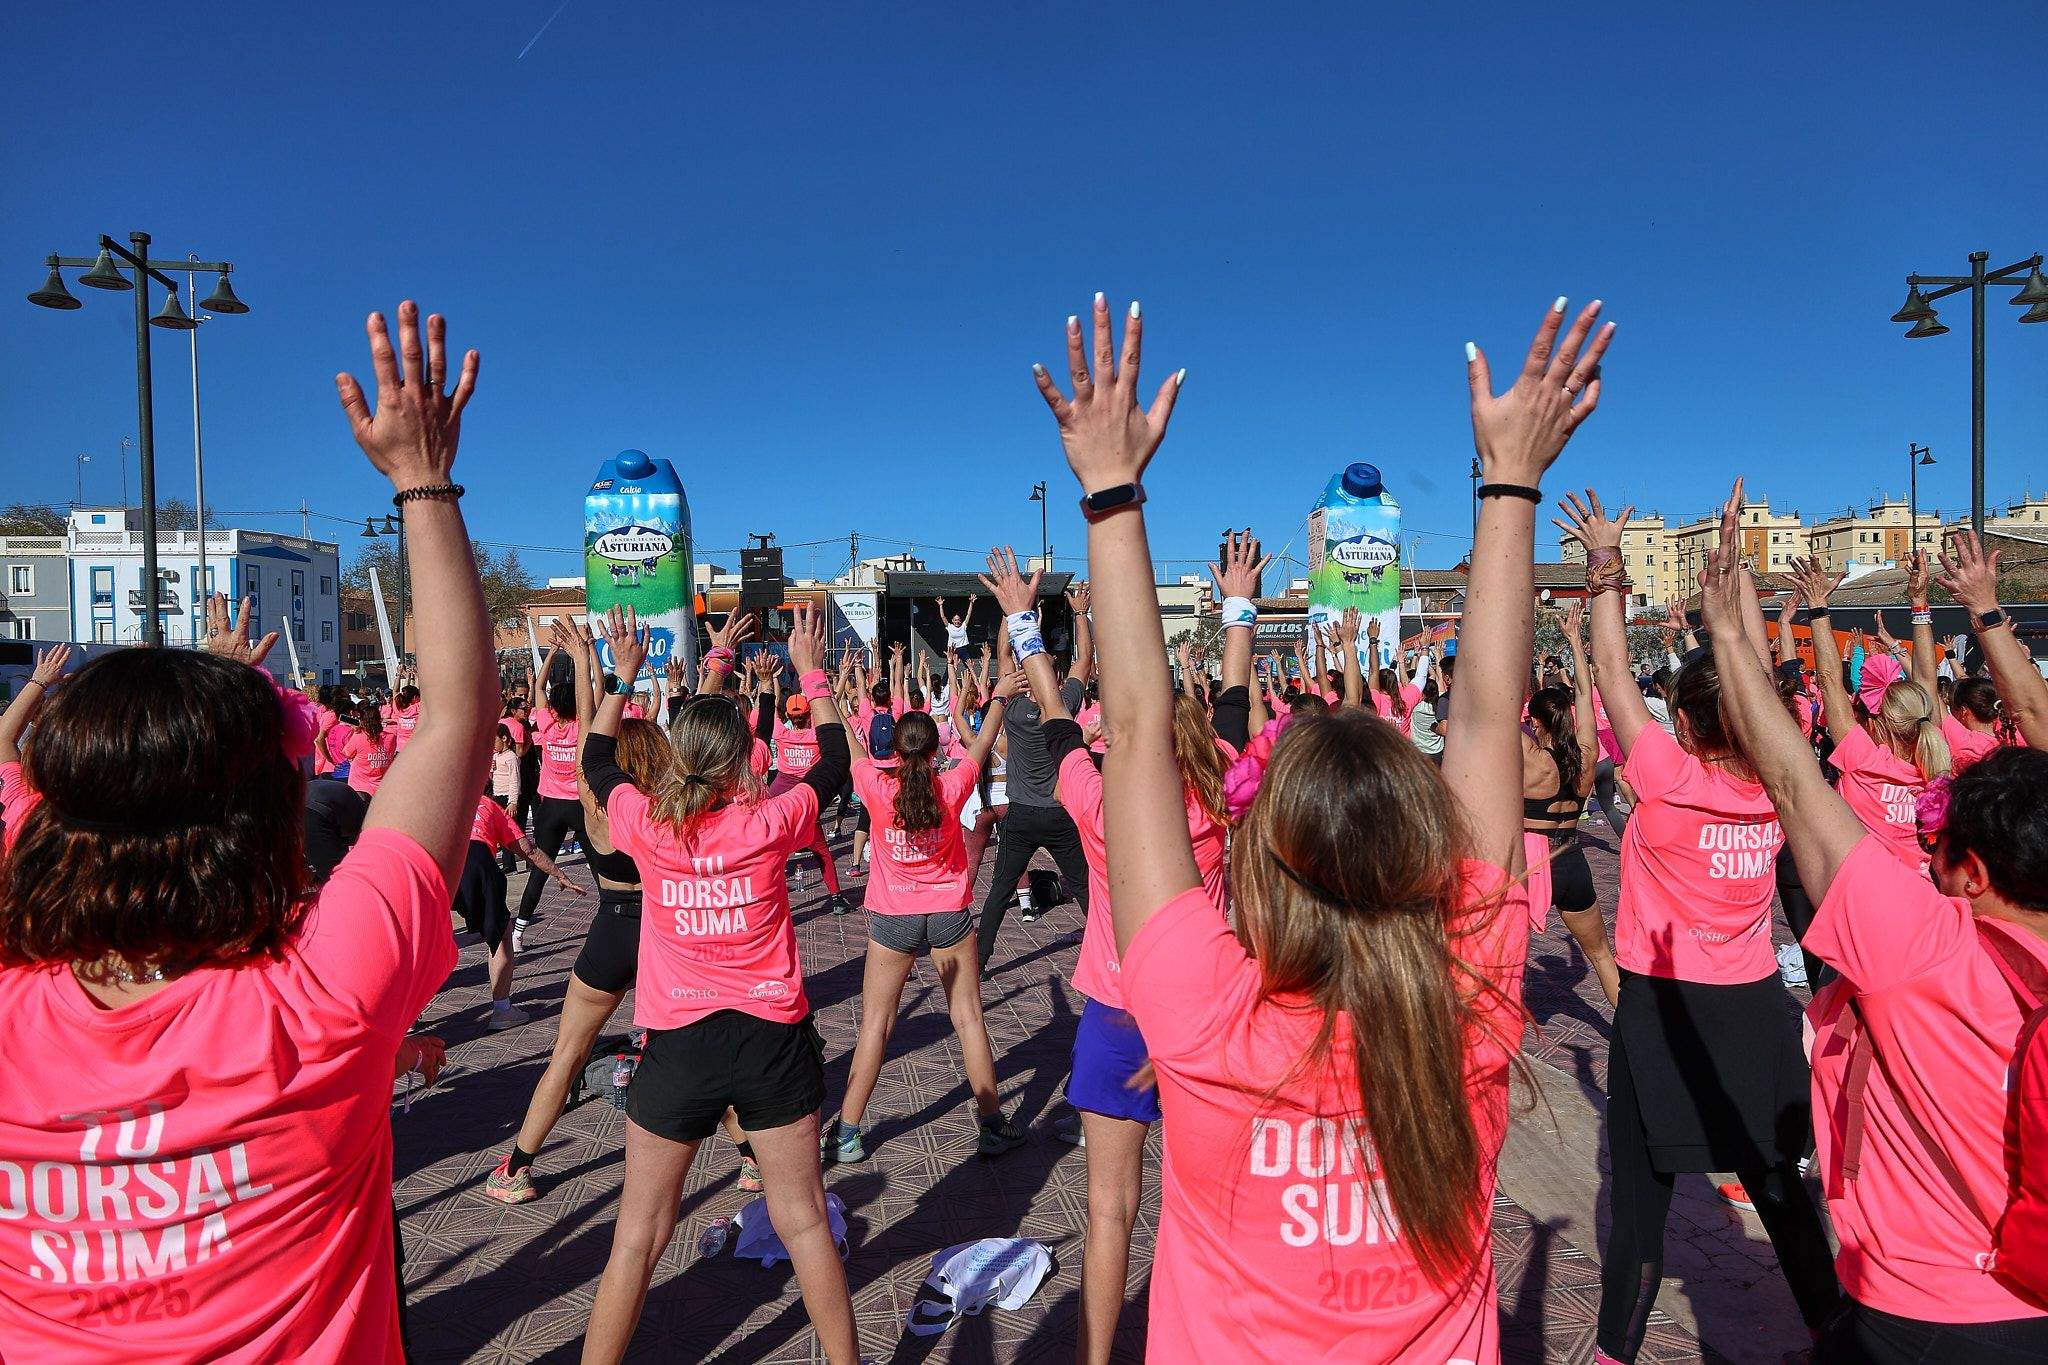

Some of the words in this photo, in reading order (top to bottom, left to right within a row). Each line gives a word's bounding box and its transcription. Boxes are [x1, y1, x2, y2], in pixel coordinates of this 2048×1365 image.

[599, 539, 668, 553] ASTURIANA
[1335, 547, 1393, 561] ASTURIANA
[1256, 622, 1303, 634] portos
[551, 752, 576, 762] SUMA
[784, 748, 815, 757] DORSAL
[788, 757, 811, 767] SUMA
[1698, 820, 1782, 850] DORSAL
[691, 856, 724, 877] TU
[1709, 848, 1772, 879] SUMA
[661, 876, 759, 908] DORSAL
[674, 908, 749, 936] SUMA
[671, 986, 719, 1000] OYSHO
[60, 1101, 165, 1161] TU
[1280, 1179, 1402, 1248] SUM
[29, 1212, 233, 1285] SUMA
[69, 1276, 190, 1328] 2025
[1318, 1265, 1420, 1313] 2025
